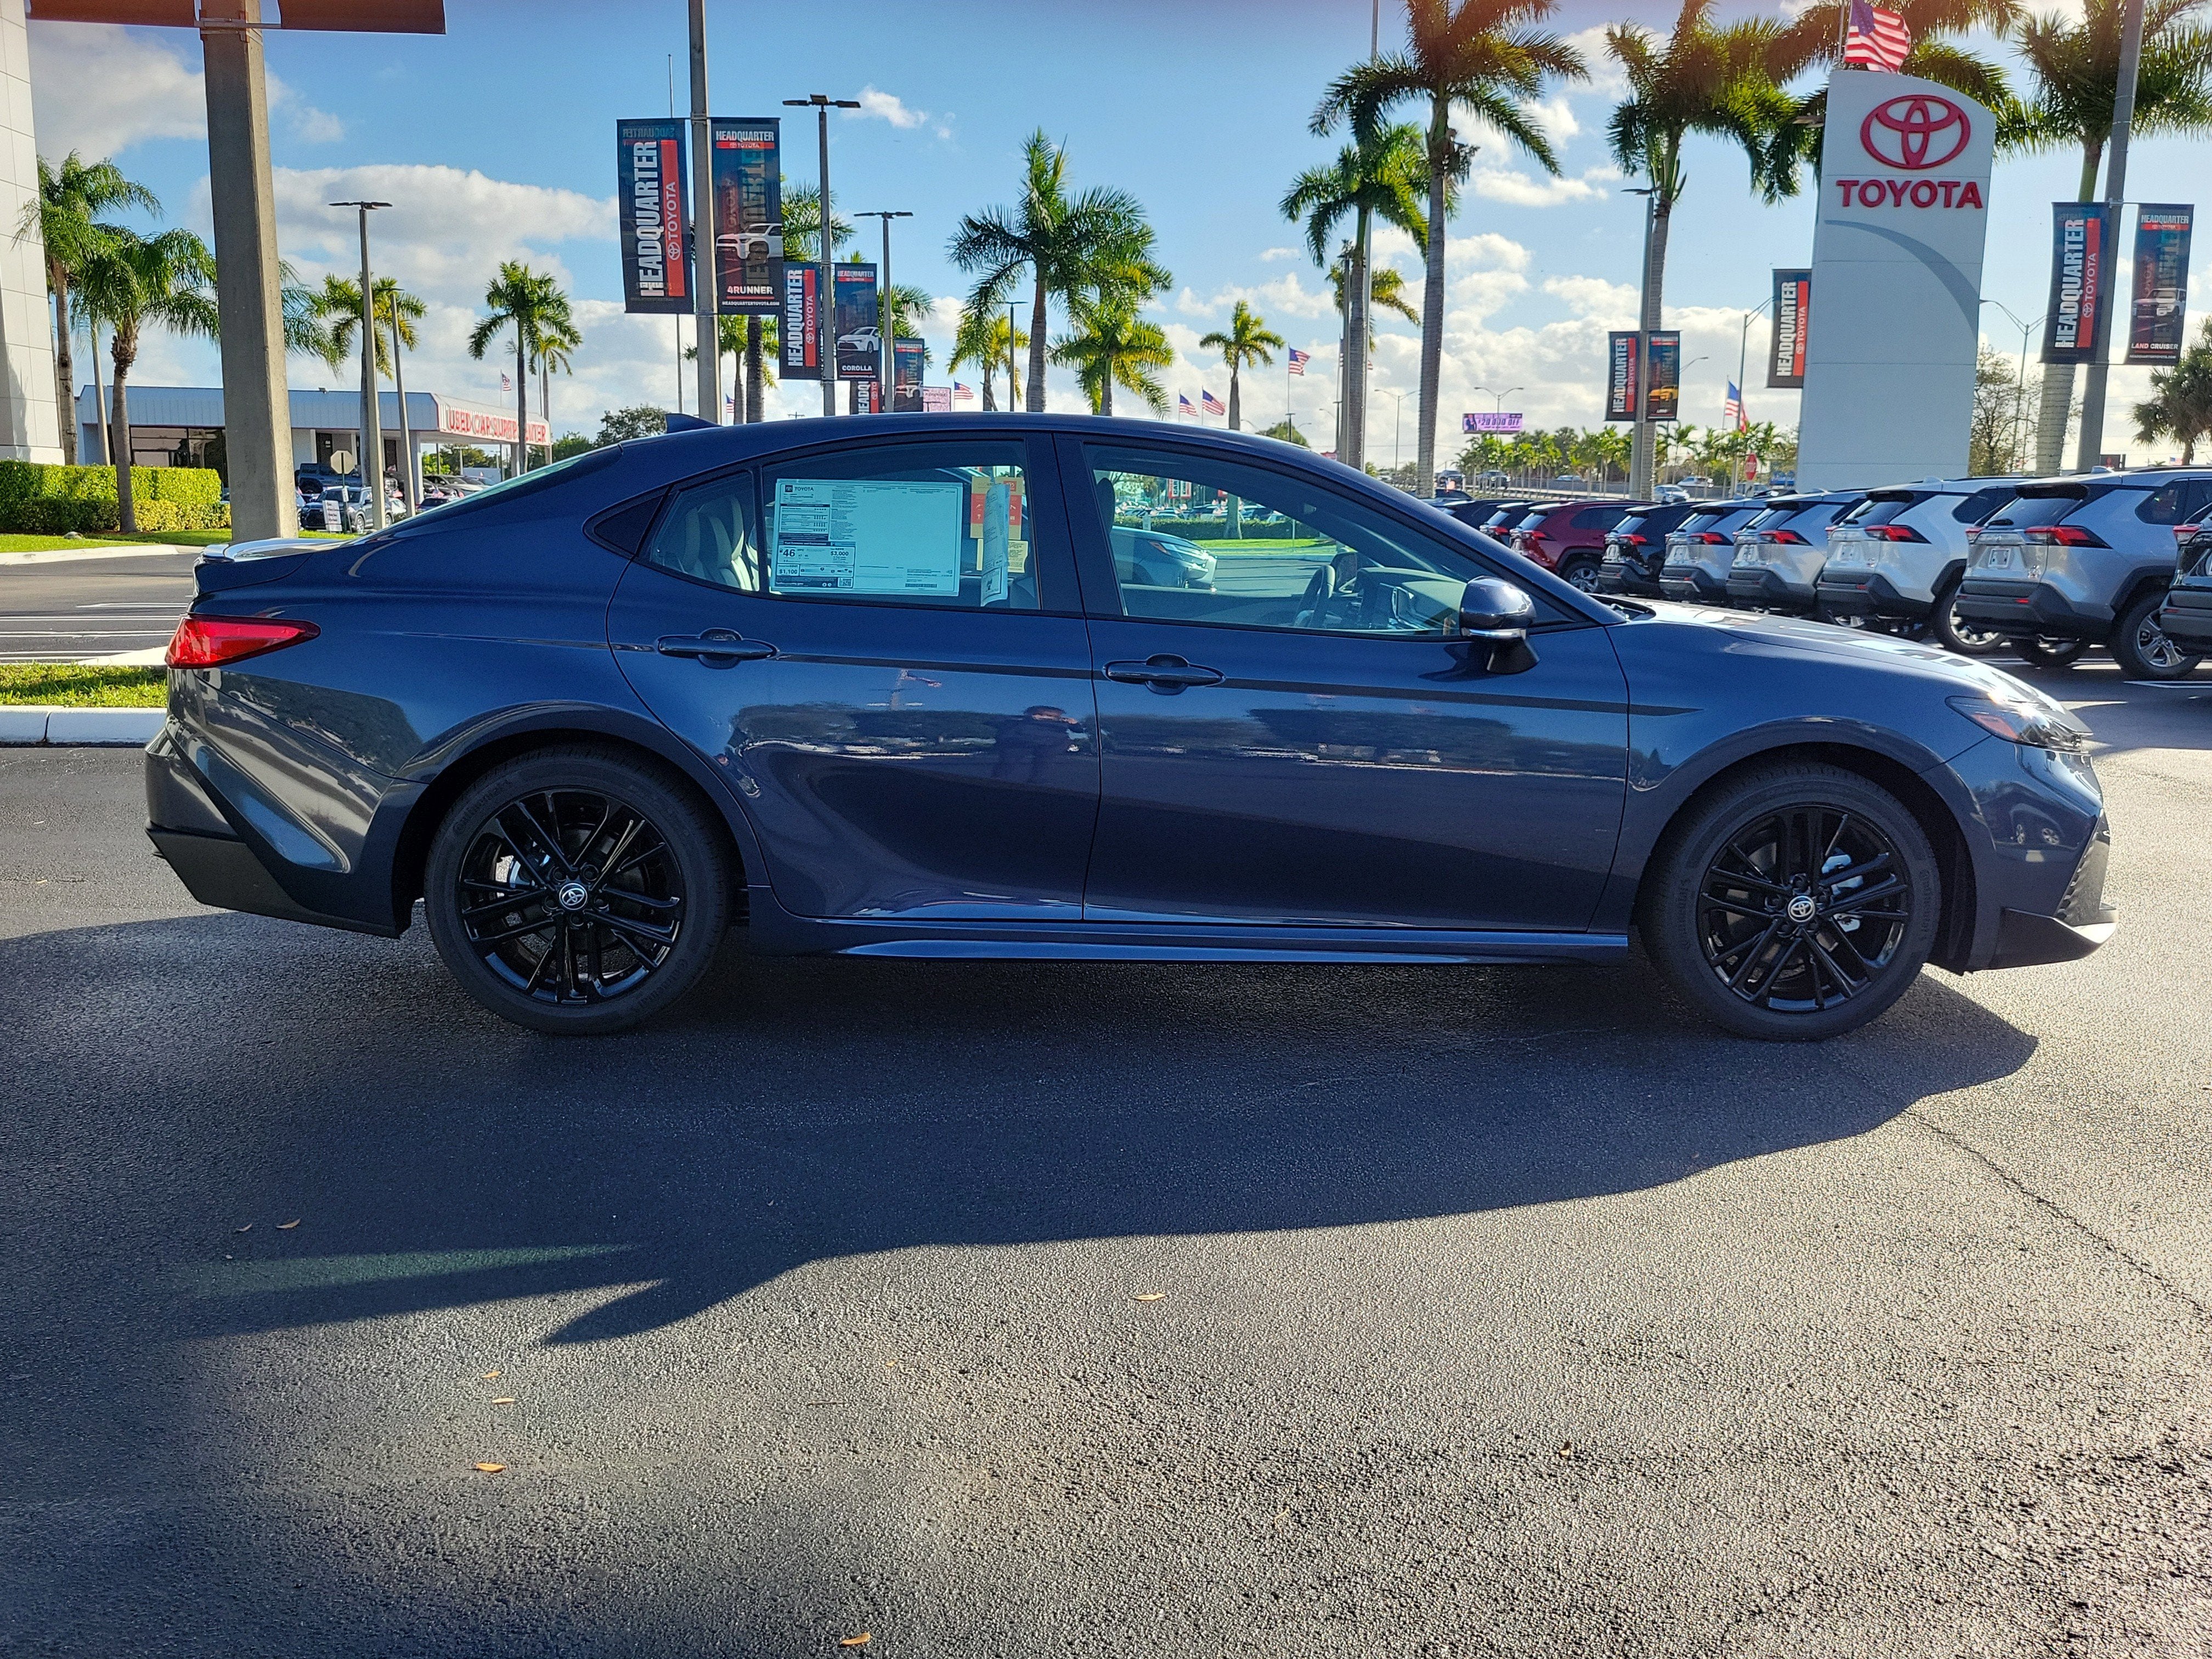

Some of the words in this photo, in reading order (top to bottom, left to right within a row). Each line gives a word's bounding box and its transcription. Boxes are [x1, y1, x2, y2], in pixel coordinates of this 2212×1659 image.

[716, 131, 775, 142] HEADQUARTER
[665, 182, 678, 240] TOYOTA
[1836, 179, 1983, 209] TOYOTA
[634, 141, 665, 297] HEADQUARTER
[2141, 215, 2189, 224] HEADQUARTER
[727, 286, 774, 294] 4RUNNER
[2055, 219, 2084, 348] HEADQUARTER
[2085, 253, 2096, 301] TOYOTA
[787, 269, 803, 366] HEADQUARTER
[1776, 281, 1797, 377] HEADQUARTER
[1796, 307, 1806, 342] TOYOTA
[1612, 338, 1628, 413] HEADQUARTER
[448, 410, 471, 432] USED
[474, 414, 490, 435] CAR
[783, 549, 795, 557] 46
